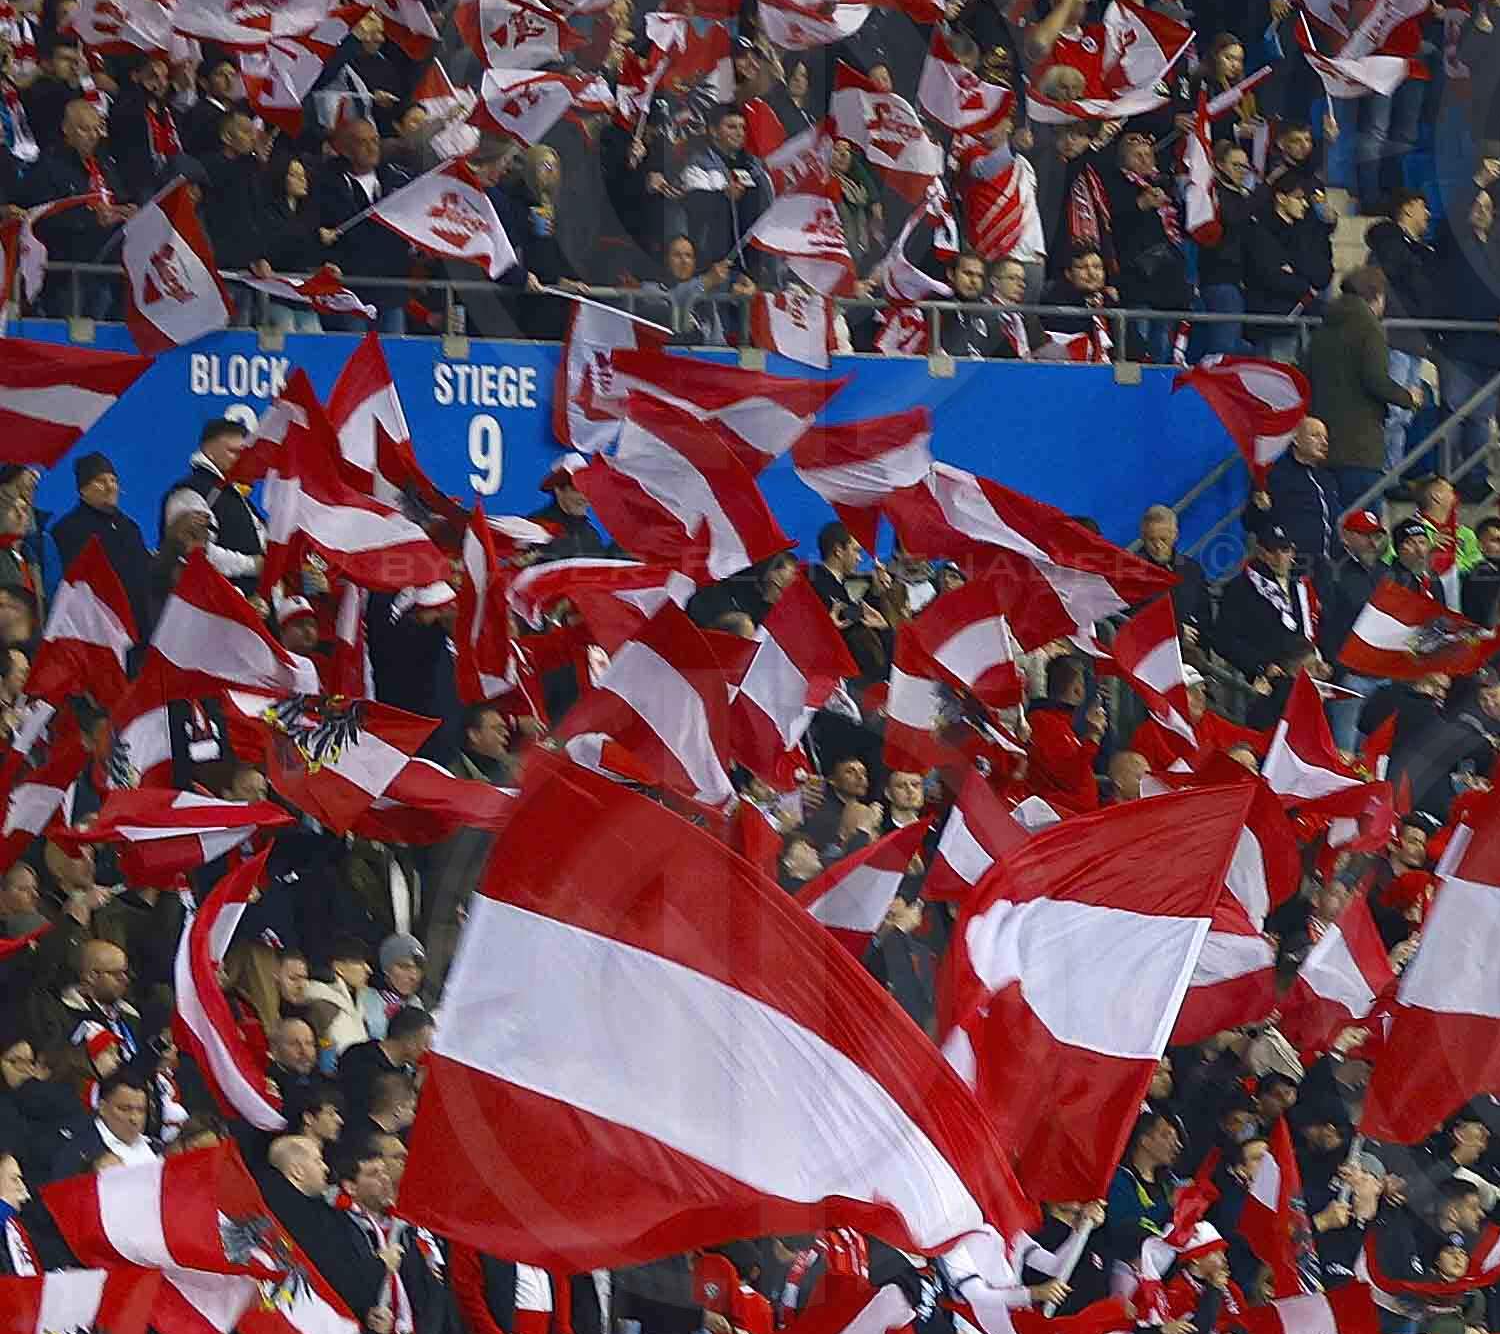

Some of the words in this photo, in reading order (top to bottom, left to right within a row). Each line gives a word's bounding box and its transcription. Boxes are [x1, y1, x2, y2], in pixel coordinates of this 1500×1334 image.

[190, 353, 291, 399] BLOCK
[434, 362, 537, 408] STIEGE
[468, 414, 503, 495] 9
